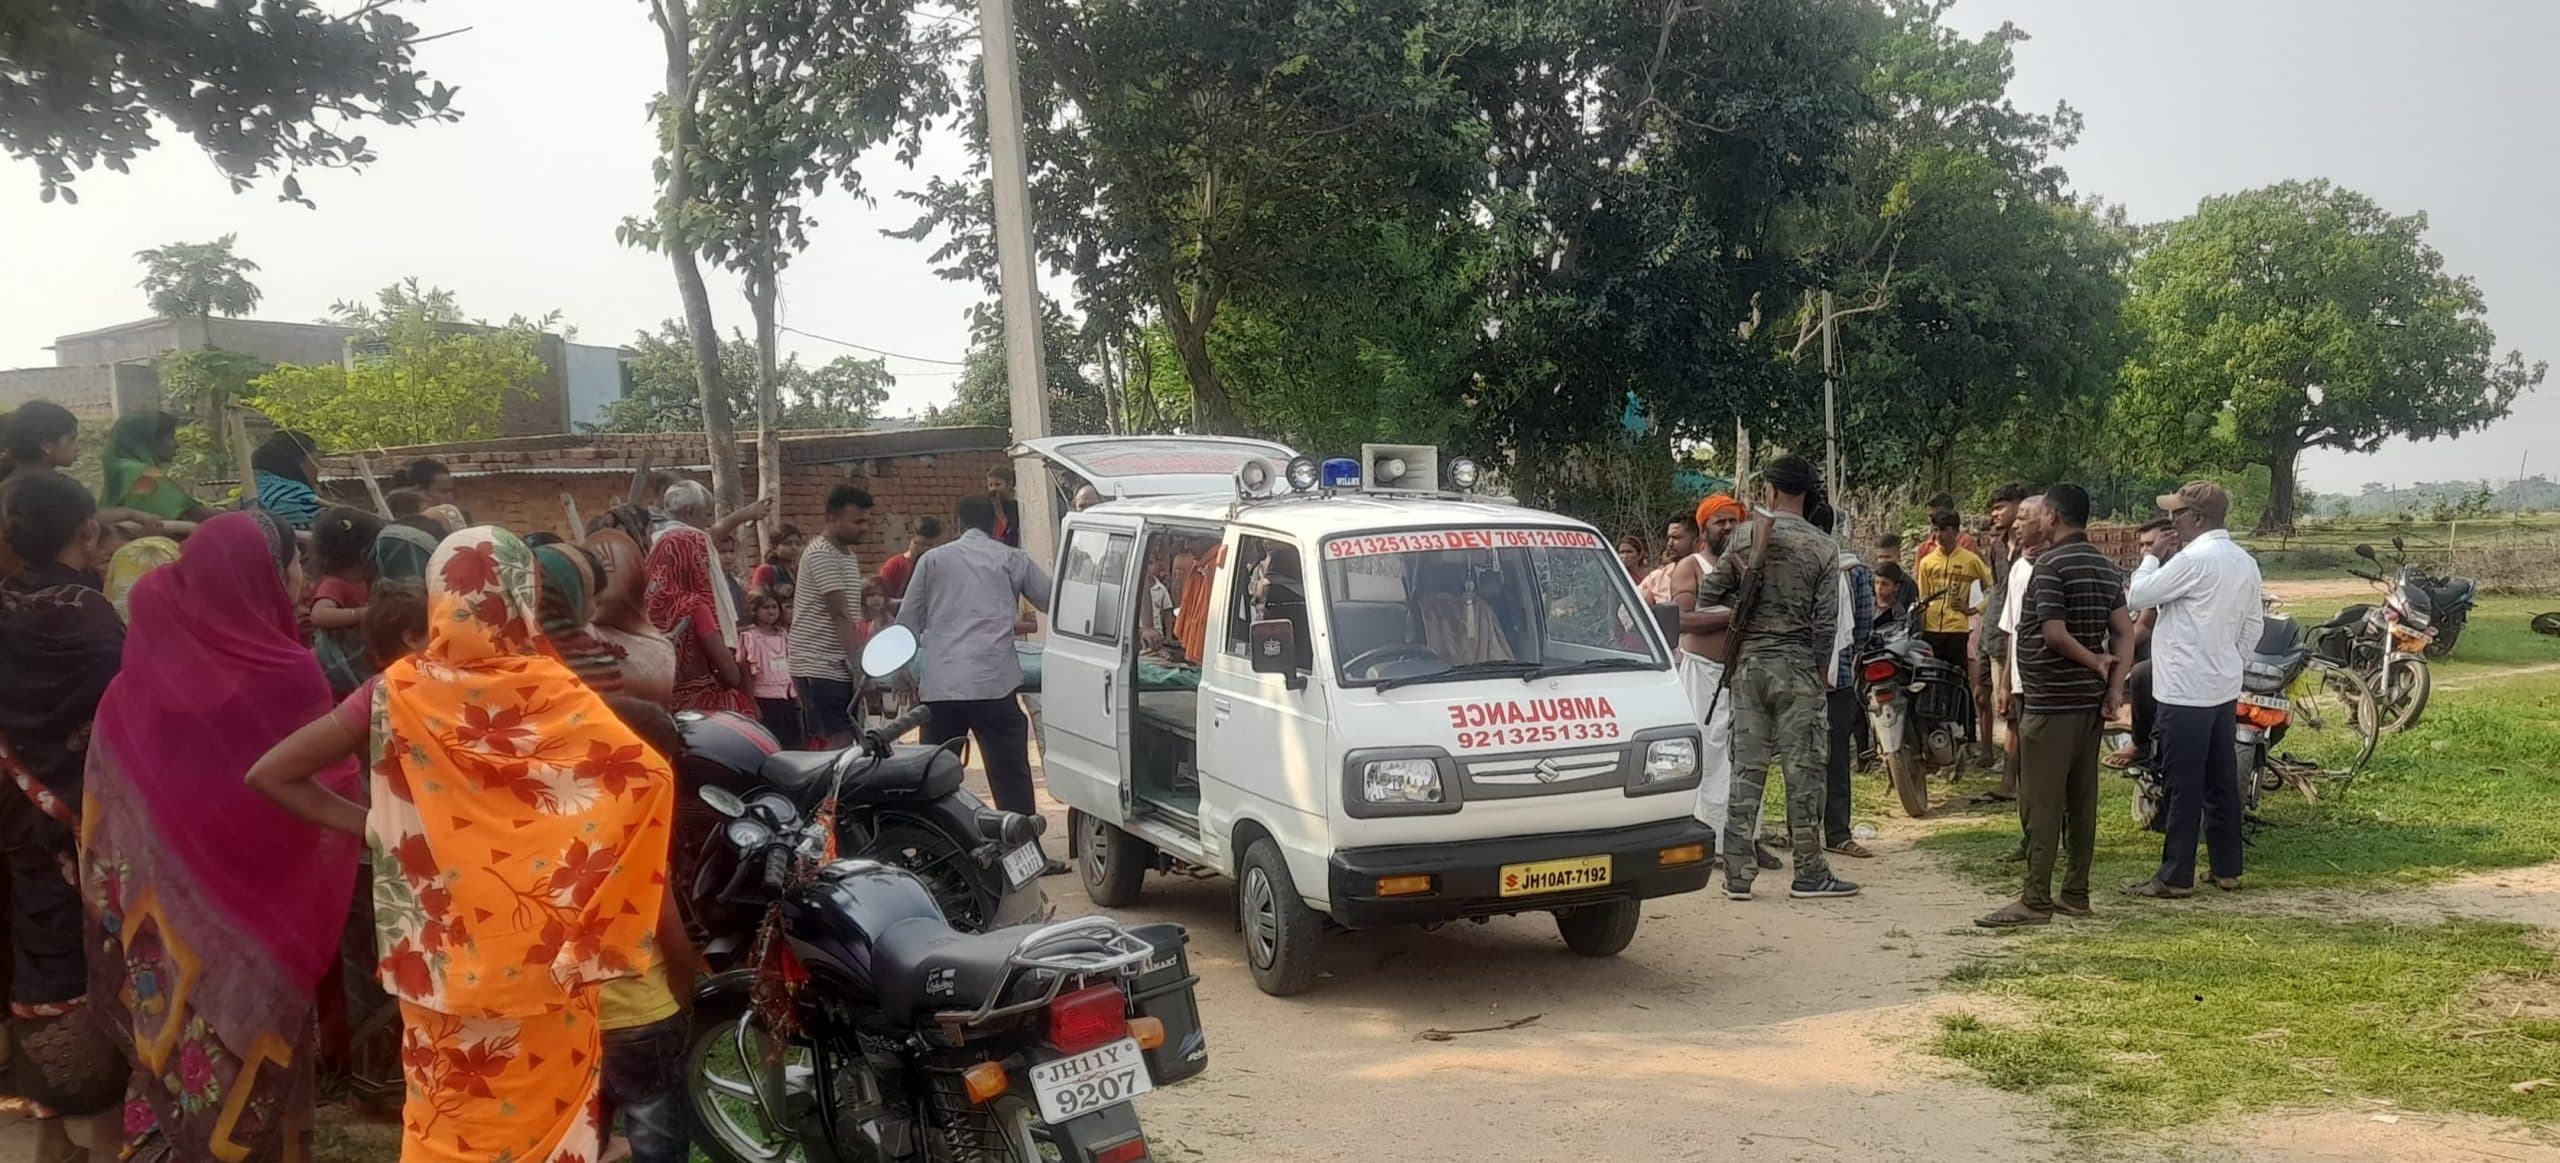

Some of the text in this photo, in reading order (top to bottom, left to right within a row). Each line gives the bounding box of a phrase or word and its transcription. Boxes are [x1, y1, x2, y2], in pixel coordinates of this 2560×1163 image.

[1328, 531, 1597, 557] 9213251333 DEV 7061210004
[1456, 722, 1620, 749] 9213251333
[1522, 866, 1606, 890] JH10AT-7192
[1049, 1046, 1119, 1083] JH11Y
[1055, 1068, 1136, 1115] 9207
